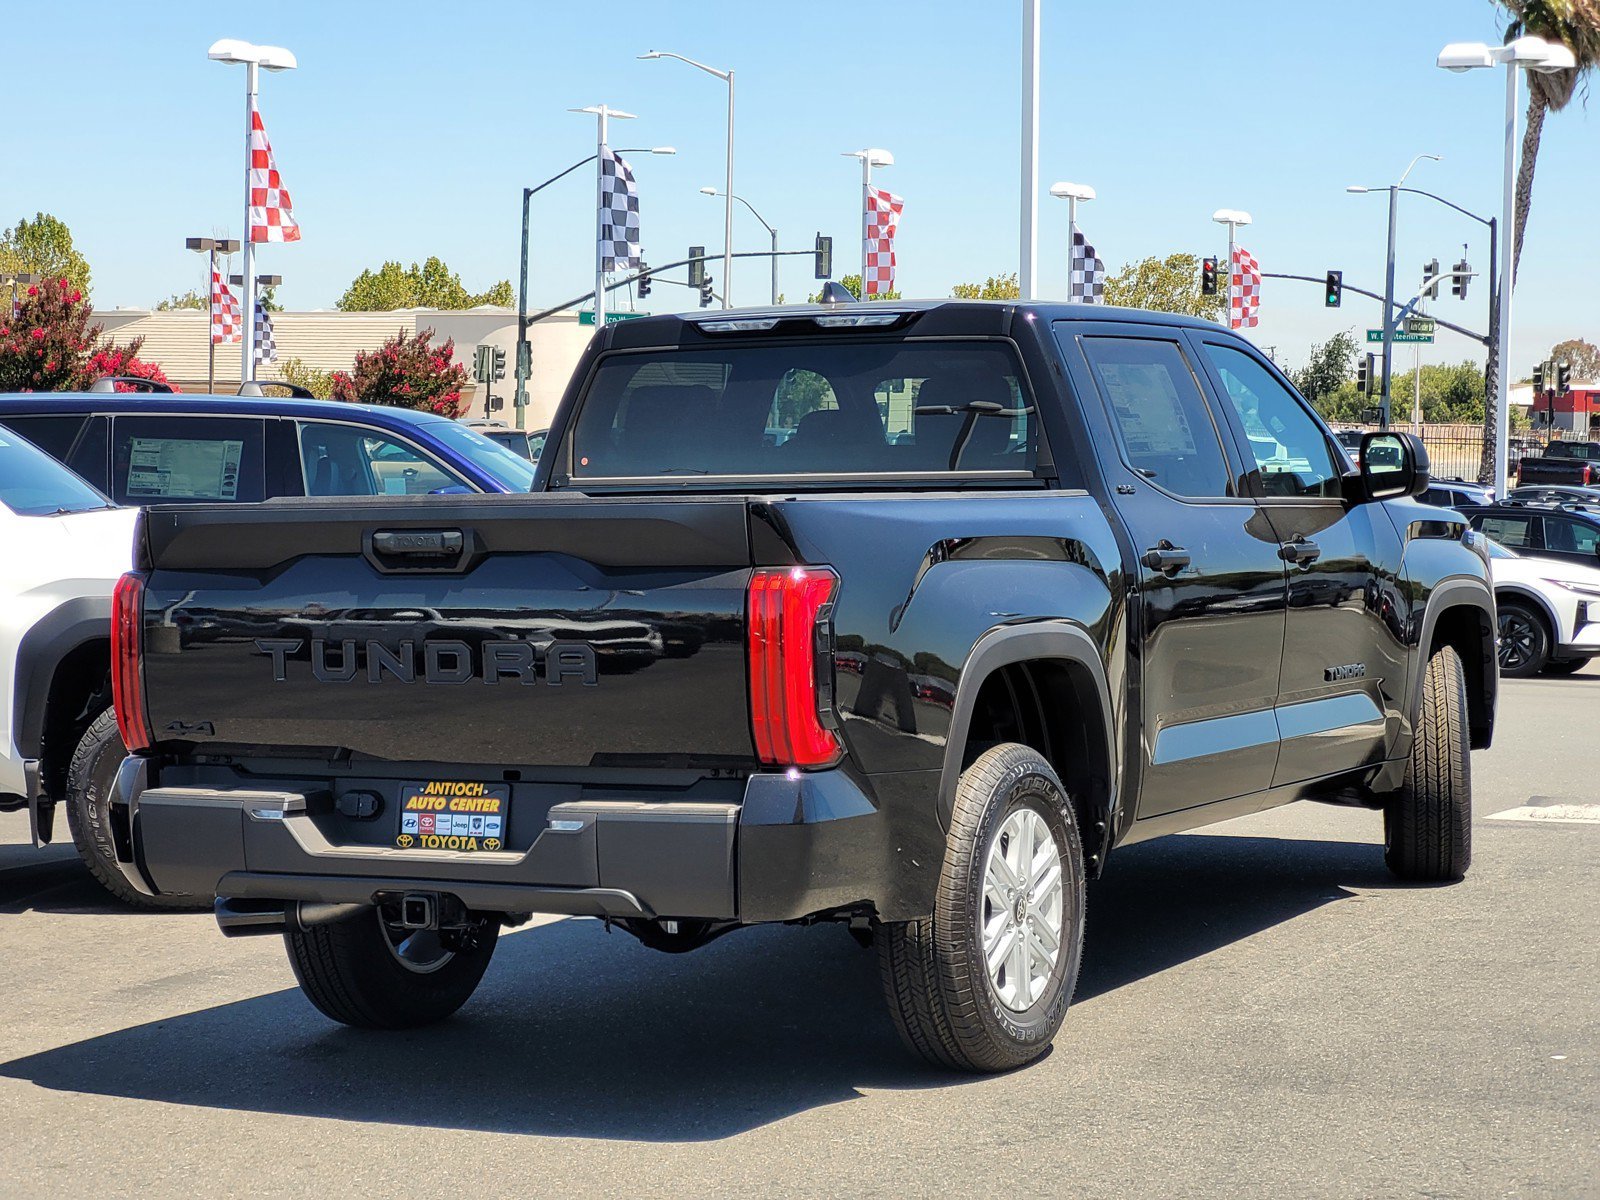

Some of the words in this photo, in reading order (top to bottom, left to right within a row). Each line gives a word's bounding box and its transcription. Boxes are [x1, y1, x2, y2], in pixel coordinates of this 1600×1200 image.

[591, 315, 617, 324] Ctco
[398, 536, 439, 546] TOYOTA
[254, 639, 598, 686] TUNDRA
[1324, 662, 1366, 682] TUNDRA
[424, 781, 484, 796] ANTIOCH
[405, 796, 447, 810] AUTO
[449, 797, 500, 812] CENTER
[453, 821, 467, 830] Jeep
[419, 835, 478, 851] TOYOTA
